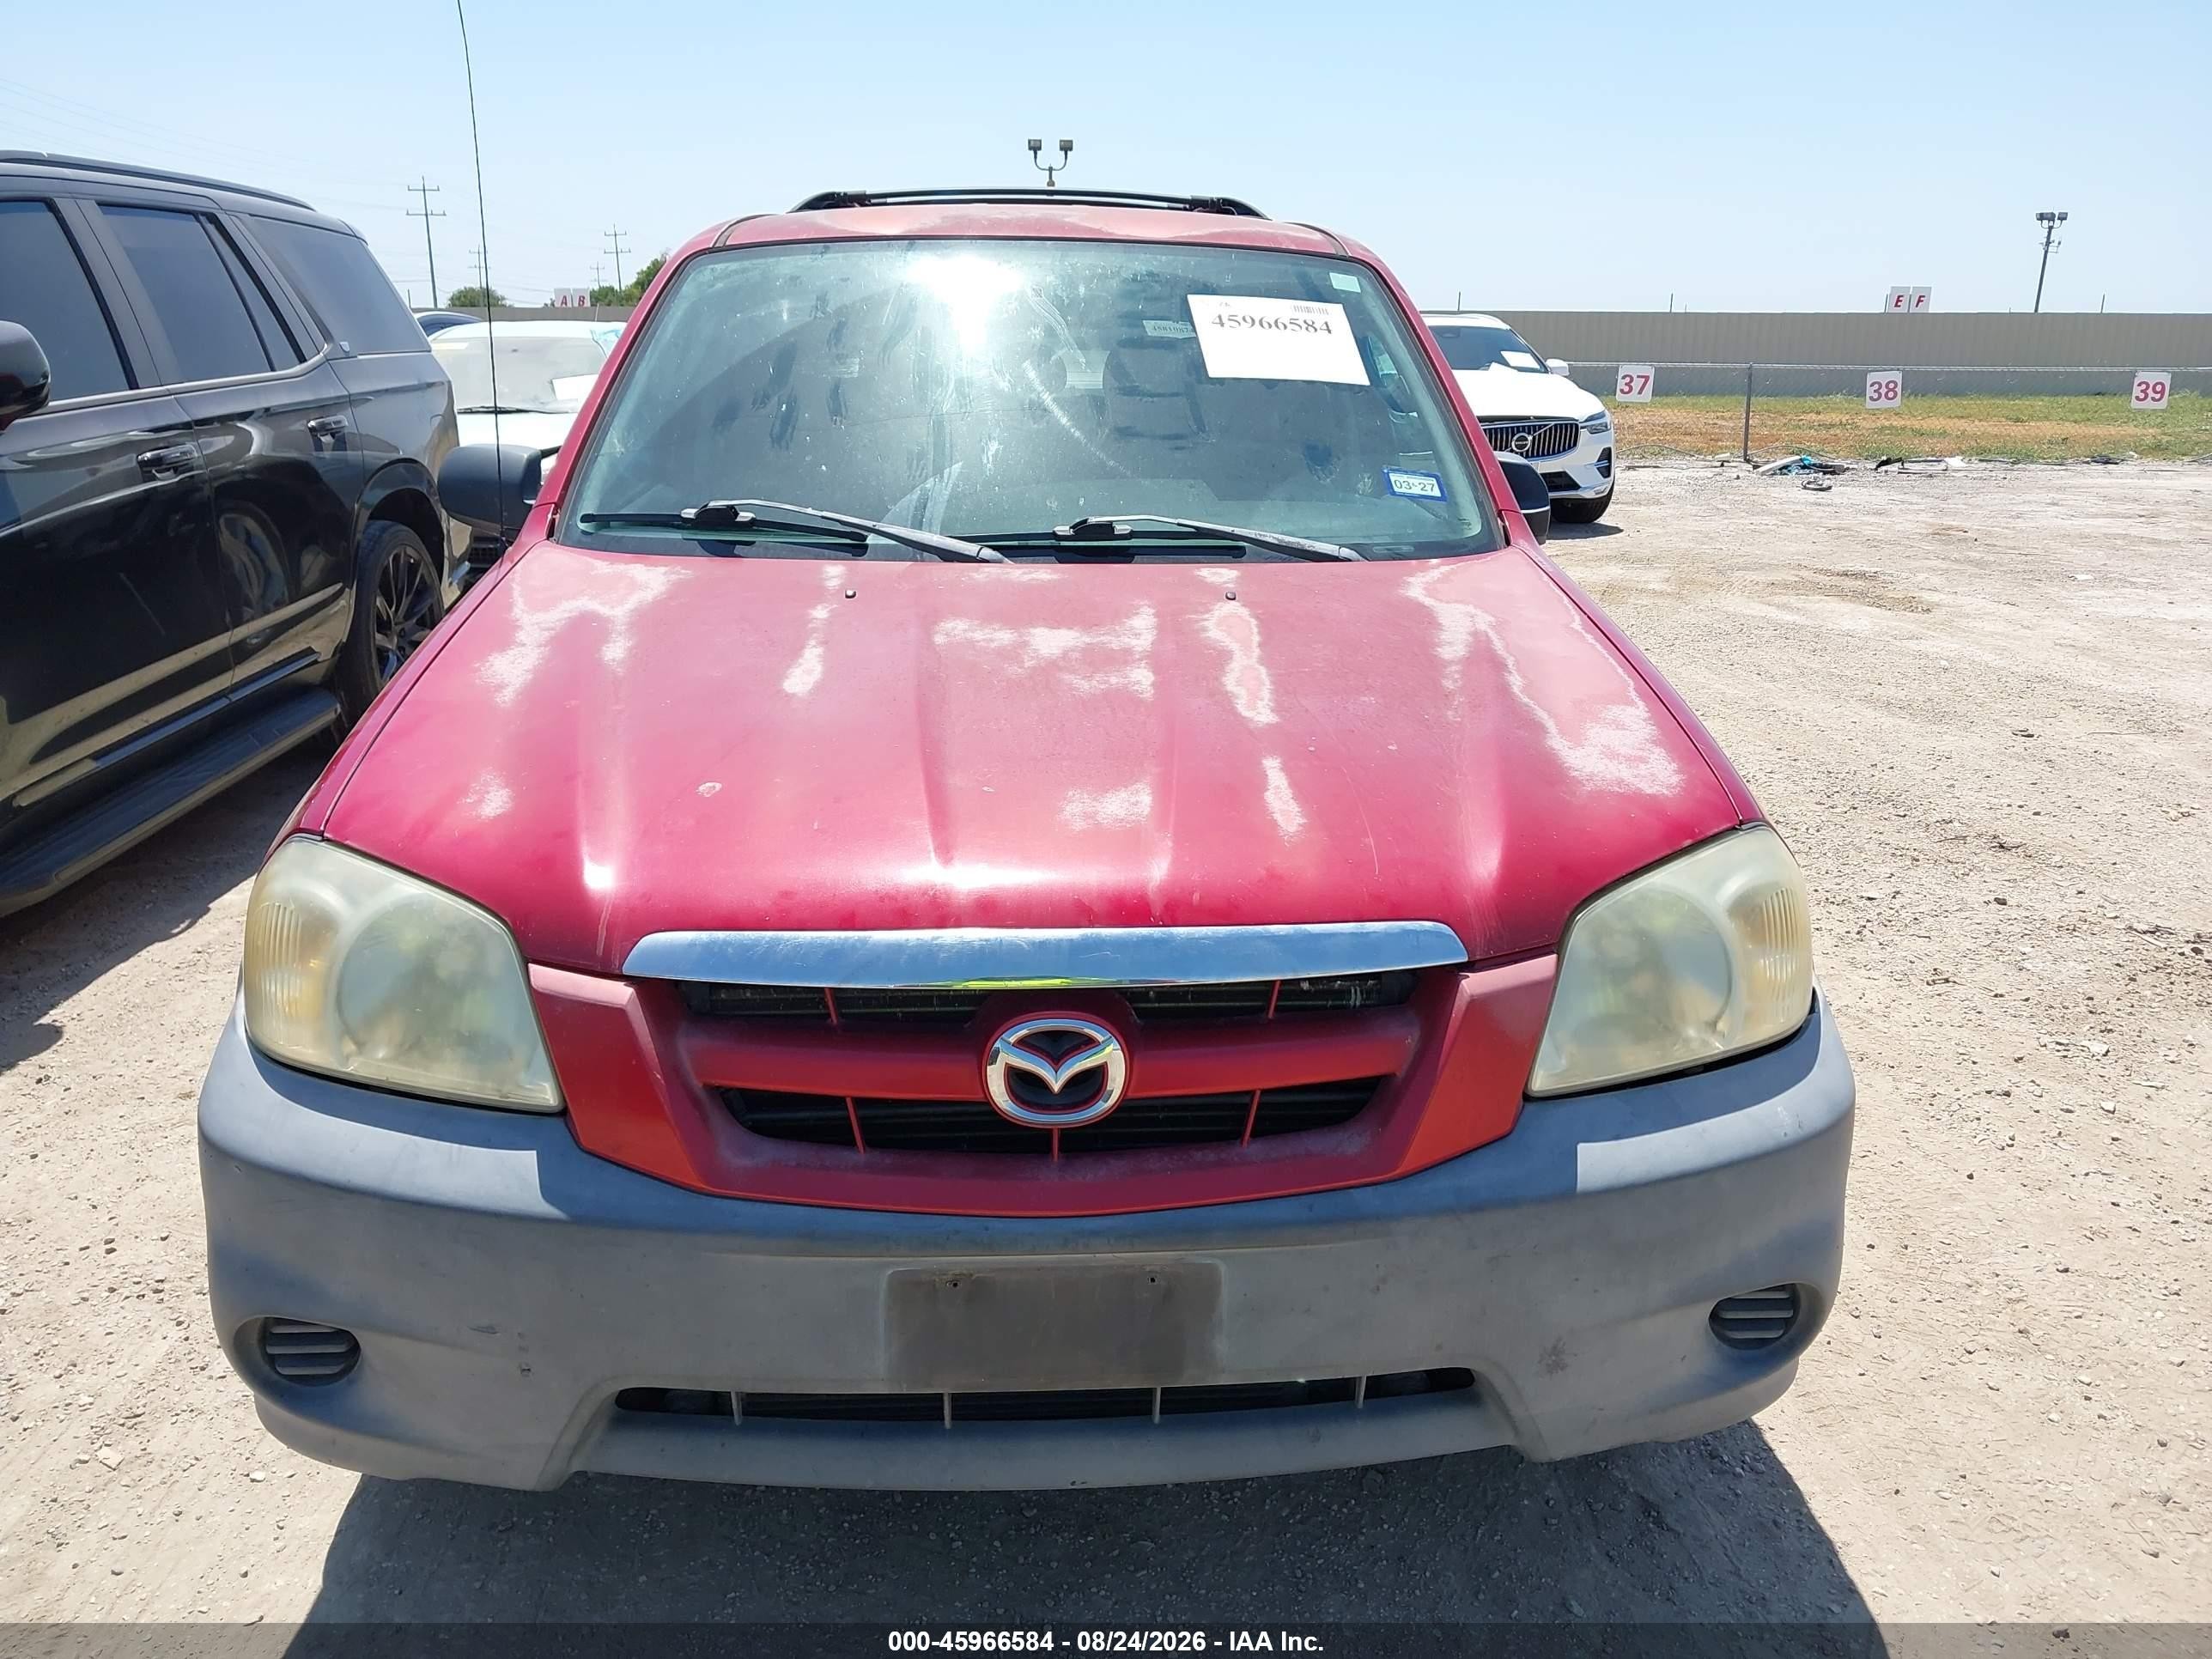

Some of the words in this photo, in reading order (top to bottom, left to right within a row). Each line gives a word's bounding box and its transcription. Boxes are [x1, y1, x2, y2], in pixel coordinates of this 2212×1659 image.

[561, 295, 568, 307] A
[578, 295, 586, 307] B
[1893, 295, 1904, 307] E
[1915, 295, 1925, 307] F
[1212, 313, 1332, 334] 45966584
[1620, 374, 1650, 395] 37
[1869, 380, 1898, 402] 38
[2135, 380, 2166, 402] 39
